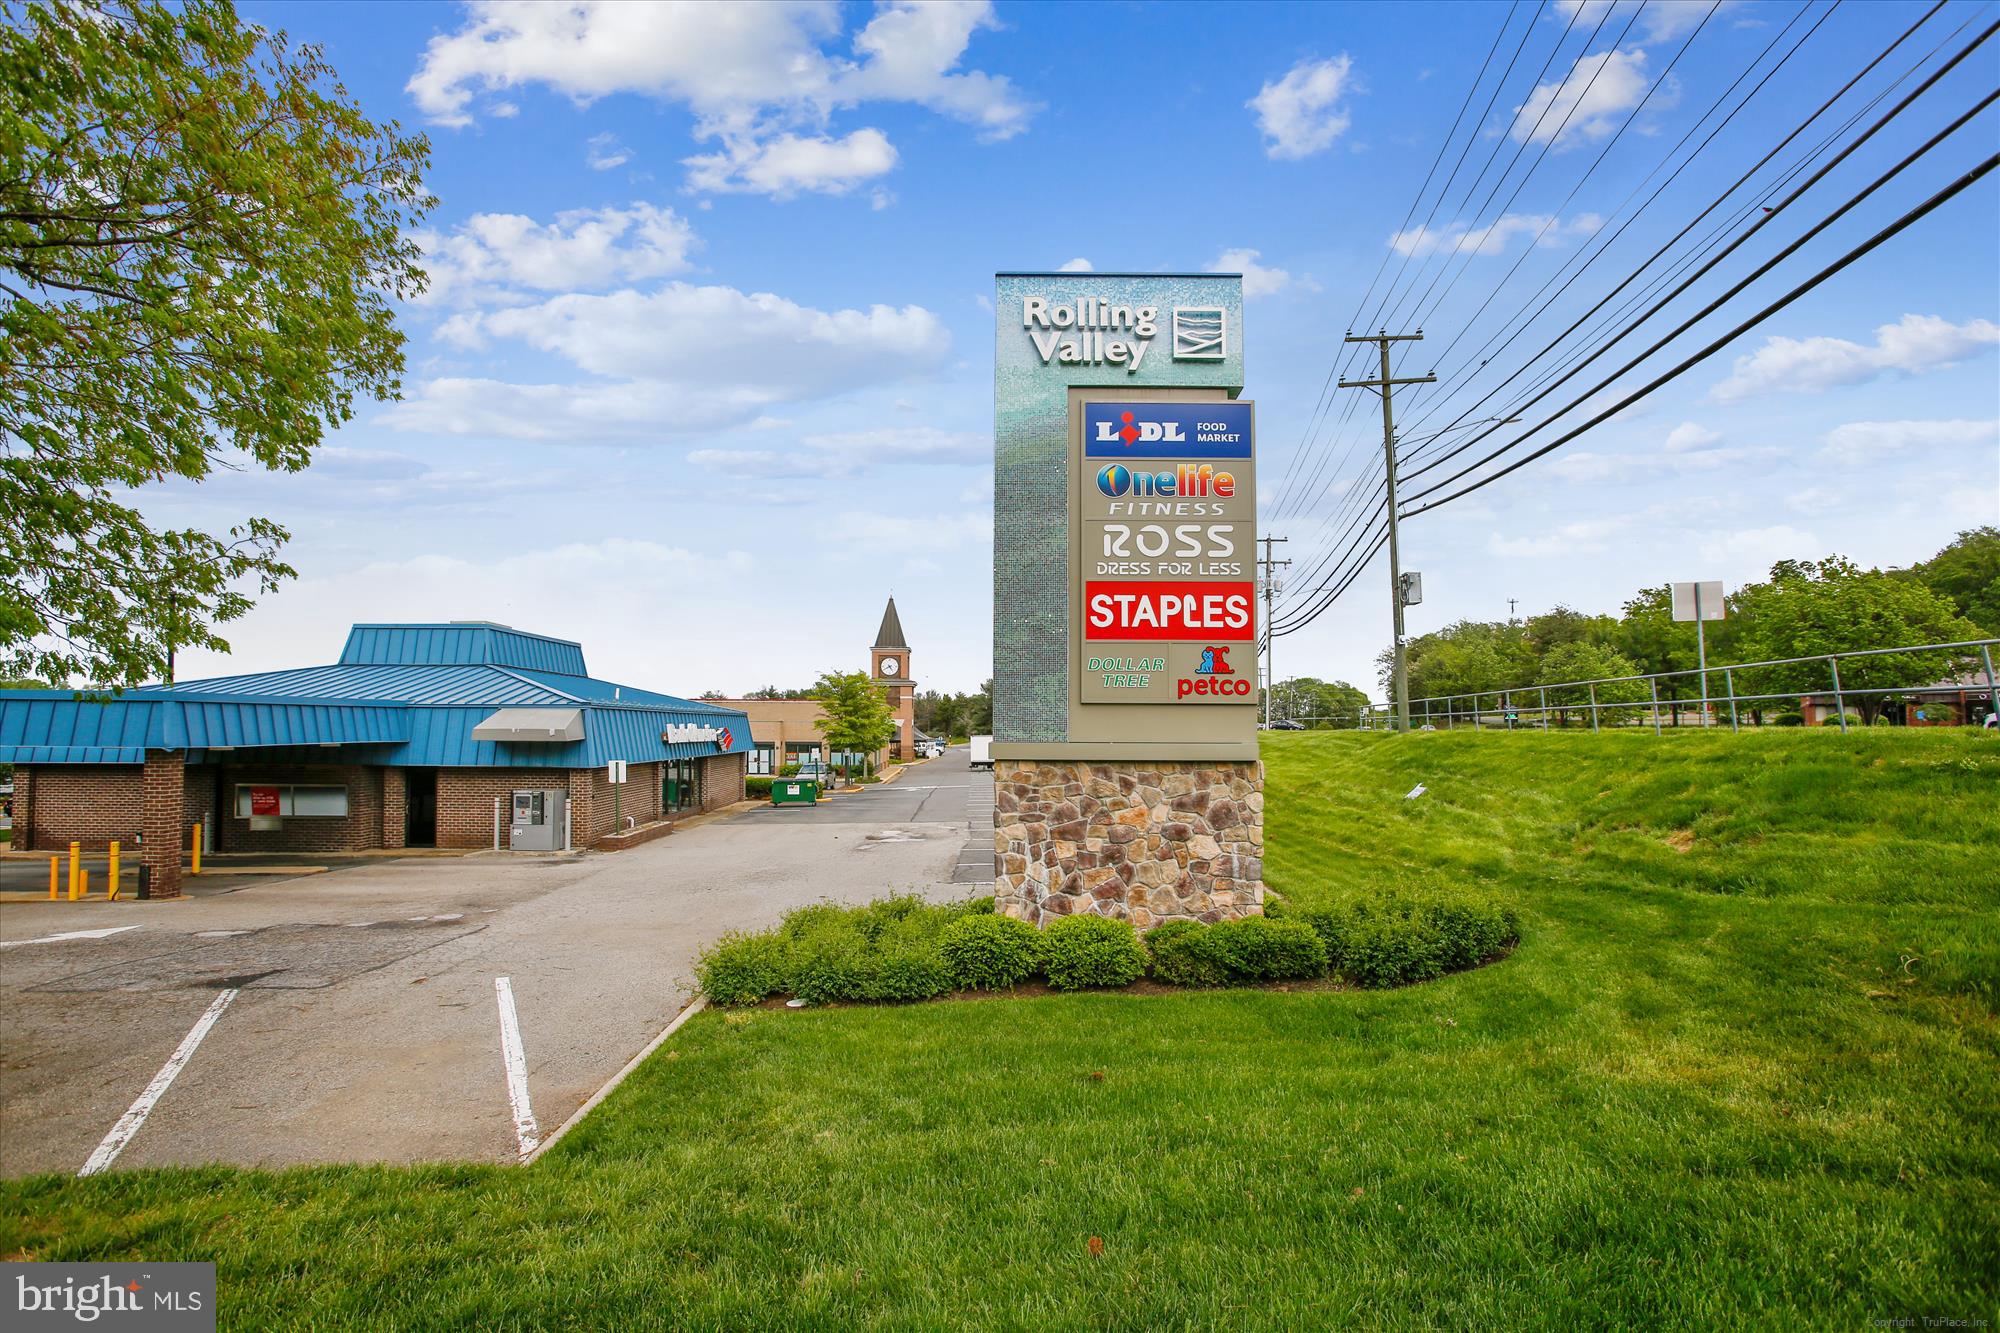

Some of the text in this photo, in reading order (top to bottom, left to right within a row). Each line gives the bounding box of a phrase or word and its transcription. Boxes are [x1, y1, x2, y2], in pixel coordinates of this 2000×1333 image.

[1023, 296, 1158, 338] Rolling
[1030, 331, 1150, 373] Valley
[1197, 423, 1226, 431] FOOD
[1197, 434, 1240, 442] MARKET
[1096, 464, 1235, 497] Onelife
[1109, 503, 1224, 515] FITNESS
[1103, 524, 1234, 557] ROSS
[1097, 562, 1241, 575] DRESS FOR LESS
[1090, 594, 1248, 628] STAPLES
[1088, 657, 1165, 671] DOLLAR
[1102, 674, 1150, 687] TREE
[1177, 676, 1251, 699] petco
